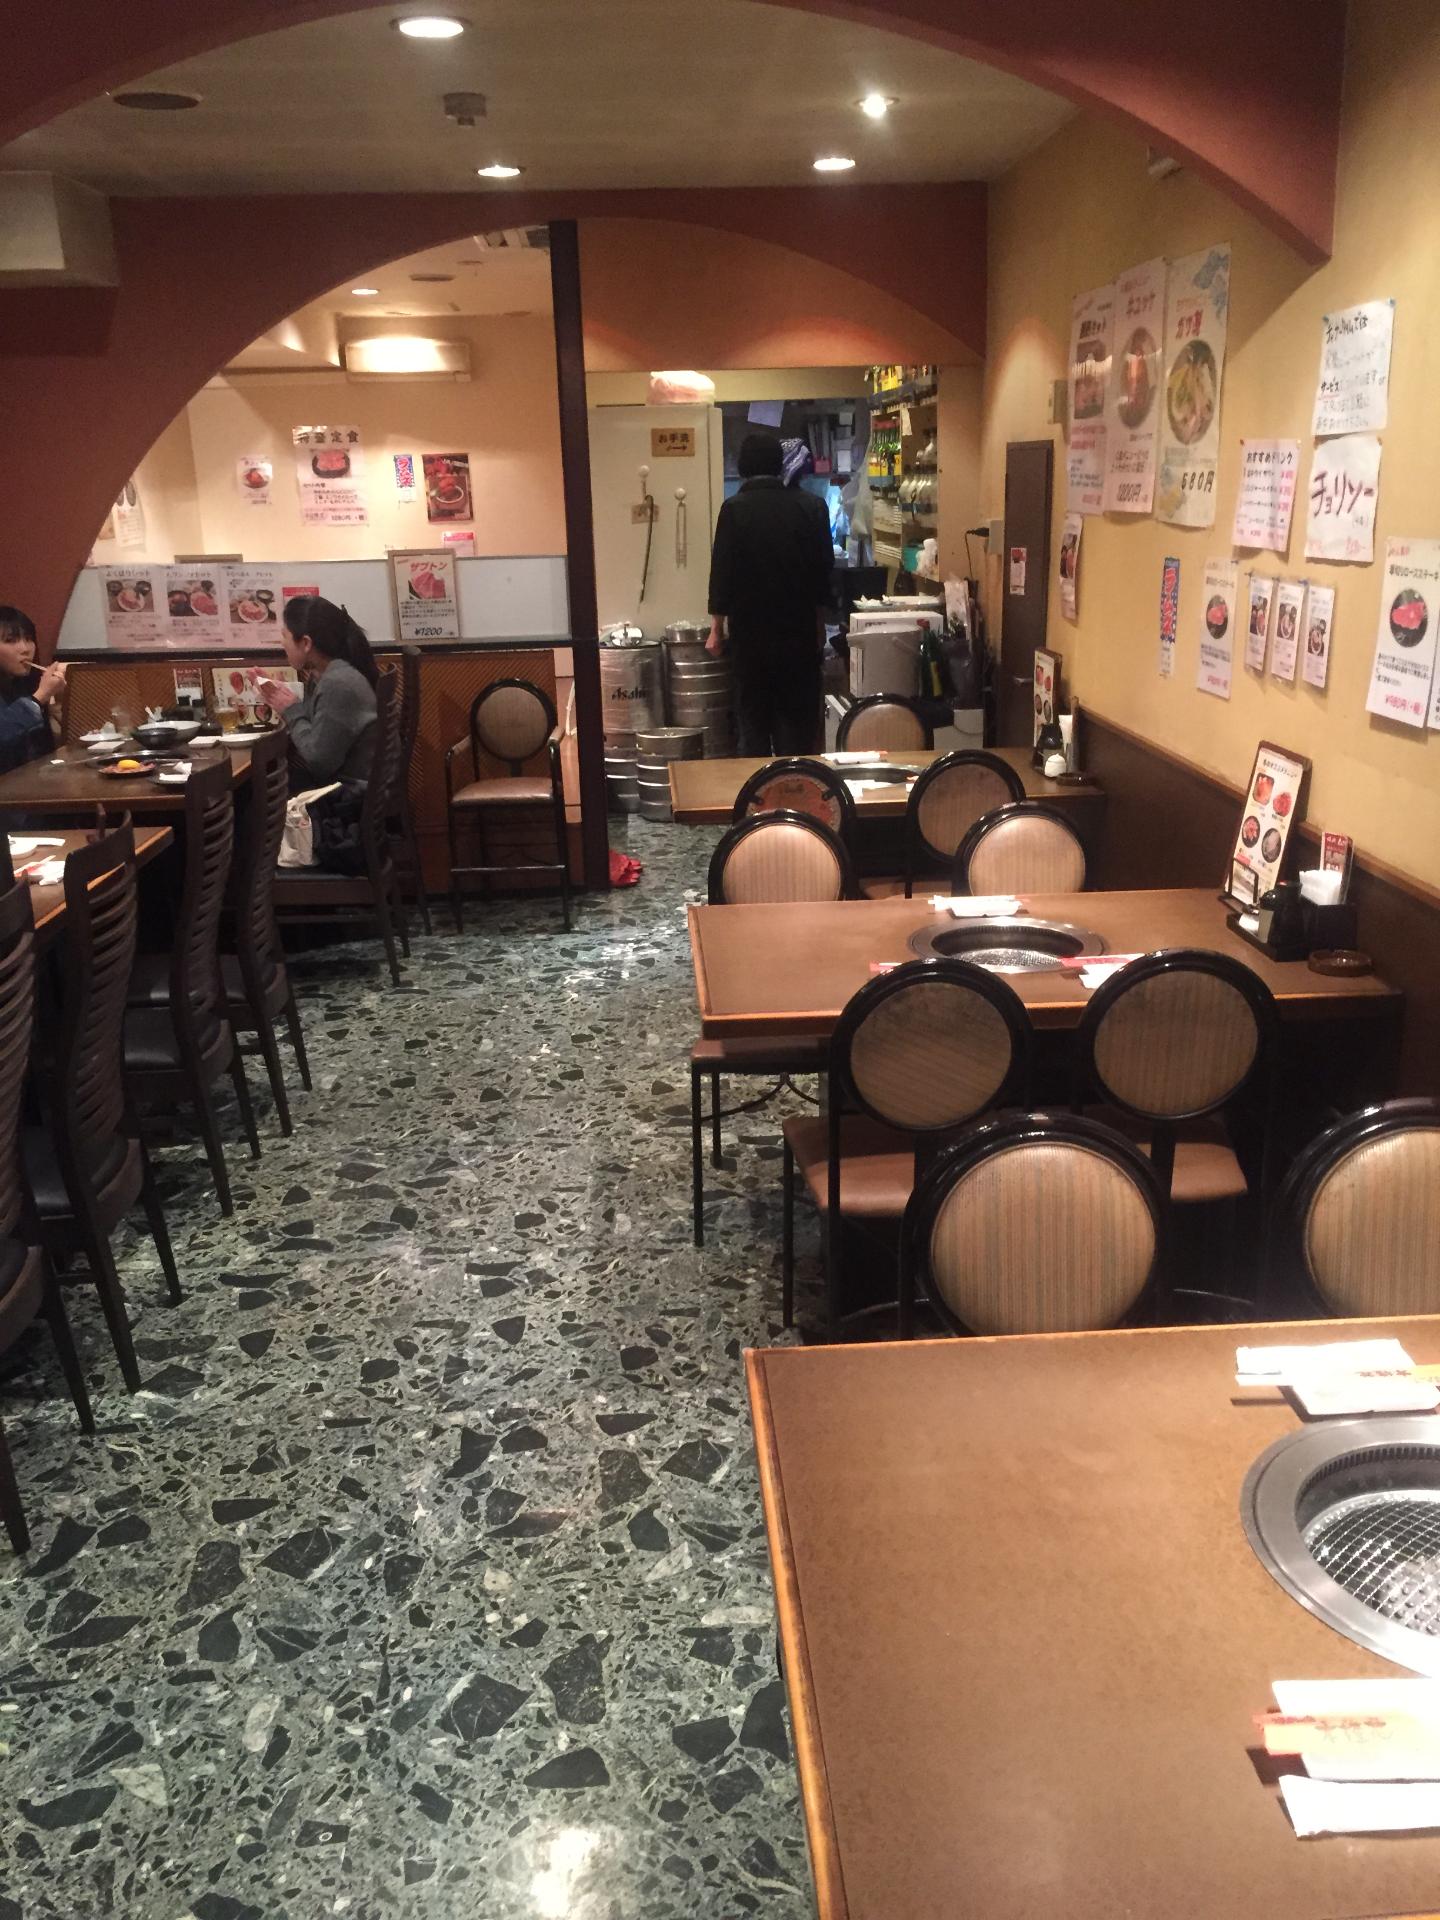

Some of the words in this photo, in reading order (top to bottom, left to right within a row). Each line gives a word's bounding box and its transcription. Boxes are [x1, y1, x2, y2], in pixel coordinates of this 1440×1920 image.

[1181, 470, 1215, 493] 580円
[1311, 471, 1374, 518] チョリソー
[411, 561, 448, 572] ザブトン
[414, 627, 443, 636] ¥1200
